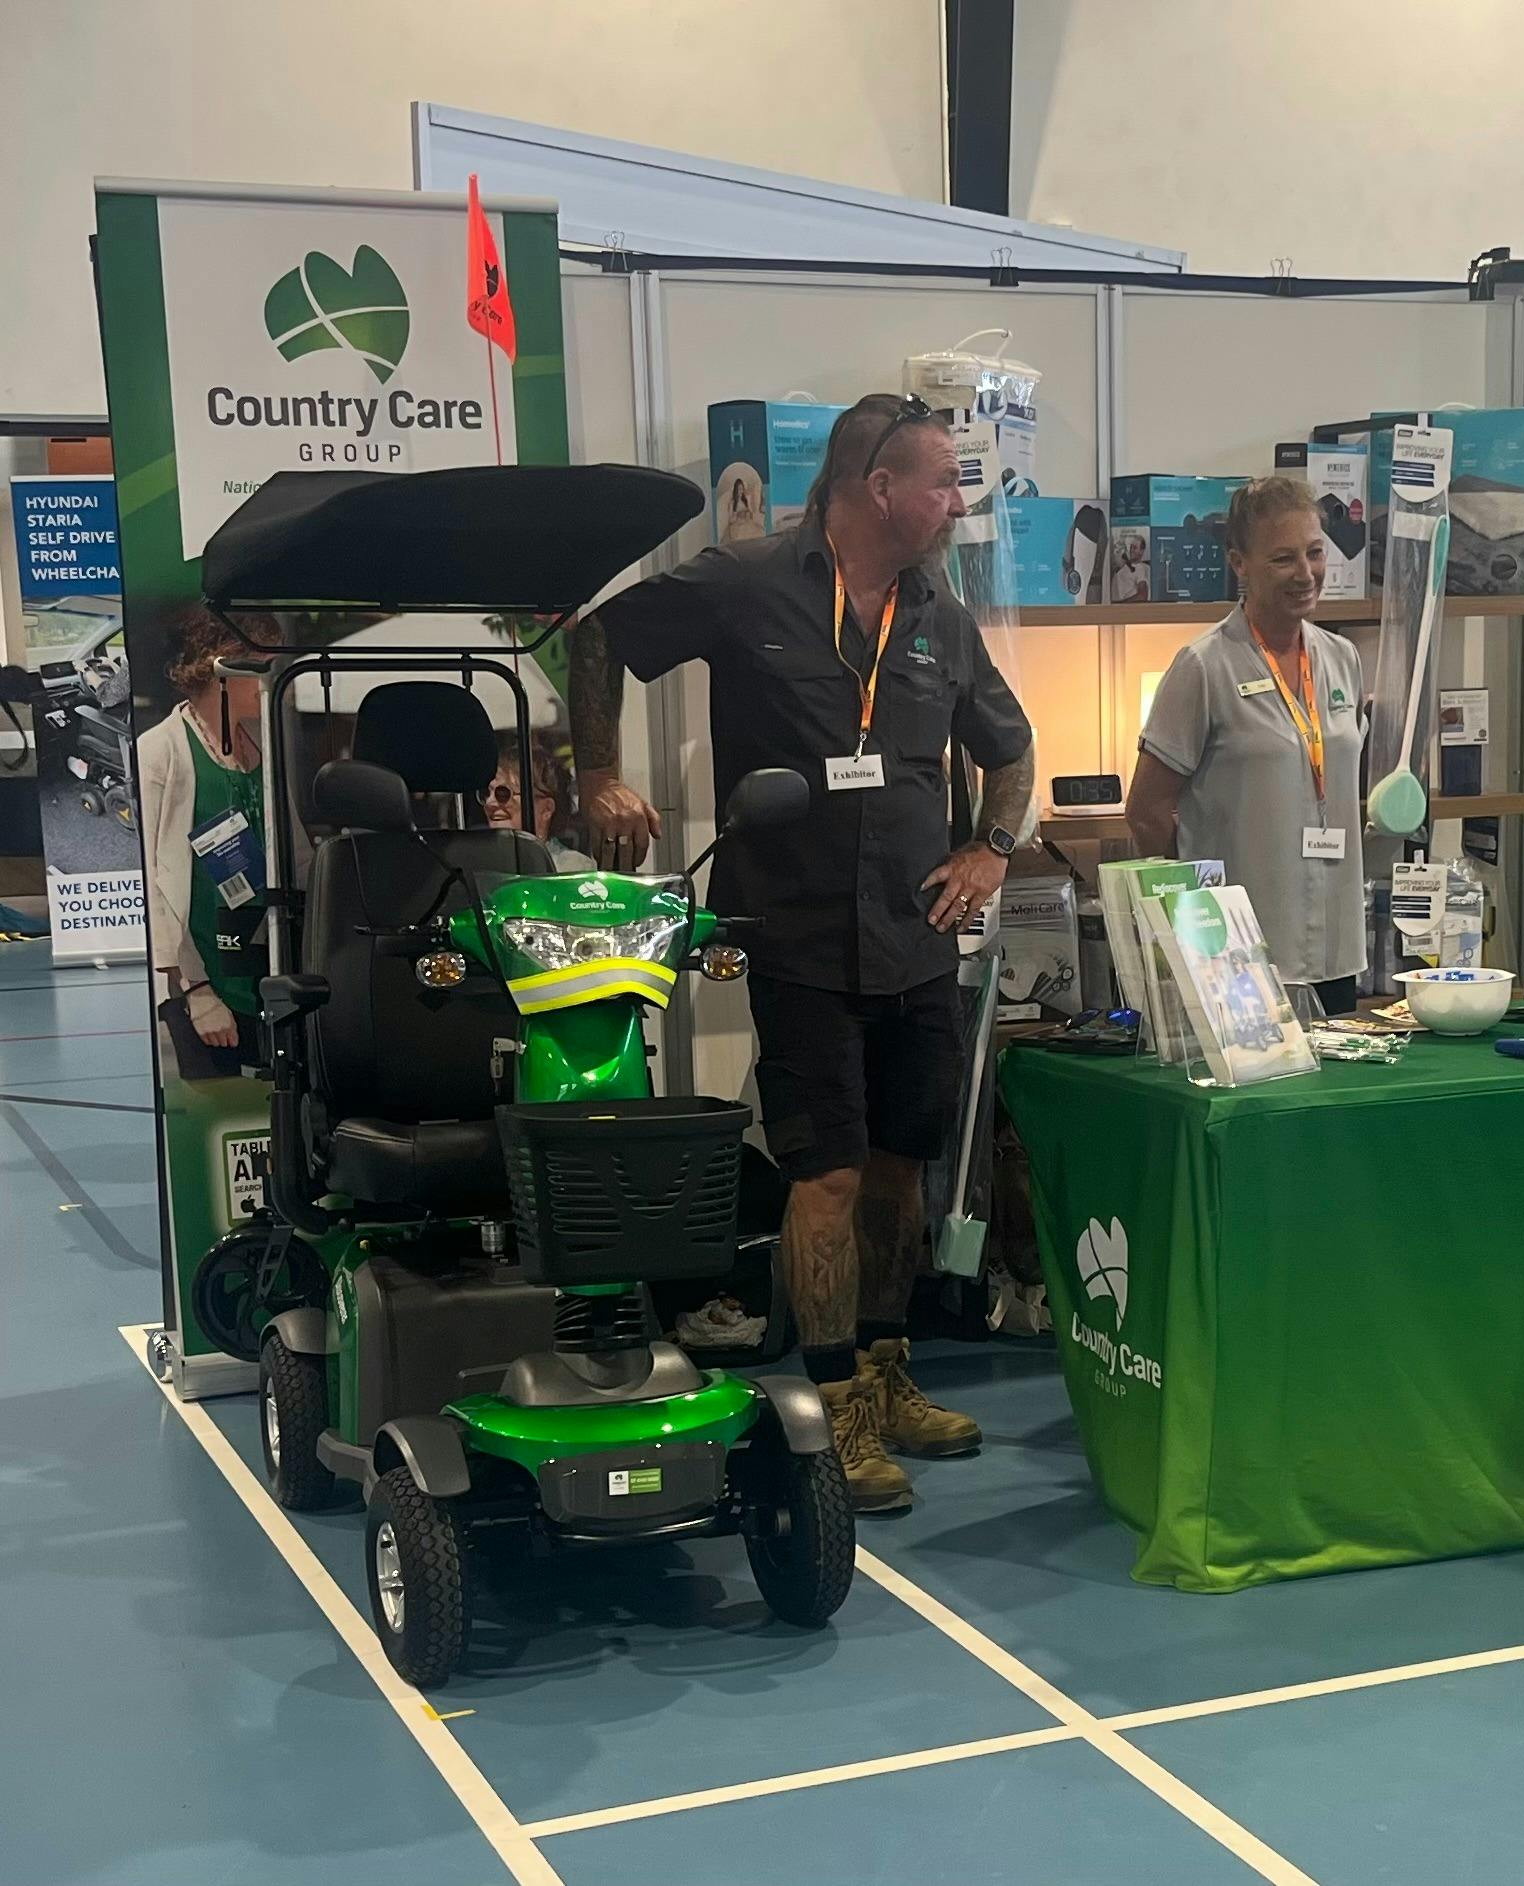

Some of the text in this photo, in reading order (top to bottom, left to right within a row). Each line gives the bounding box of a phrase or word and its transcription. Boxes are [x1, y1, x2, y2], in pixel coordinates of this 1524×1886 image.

[207, 386, 483, 437] Country Care
[299, 443, 401, 463] GROUP
[26, 496, 98, 509] HYUNDAI
[27, 514, 83, 527] STARIA
[28, 531, 116, 545] SELF DRIVE
[31, 549, 77, 562] FROM
[32, 566, 120, 581] WHEELCHA
[833, 770, 876, 780] Exhibitor
[57, 880, 142, 896] WE DELIVE
[58, 897, 145, 912] YOU CHOO
[61, 914, 146, 930] DESTINATI
[234, 1184, 262, 1193] SEARC
[1072, 1312, 1162, 1389] Country Care
